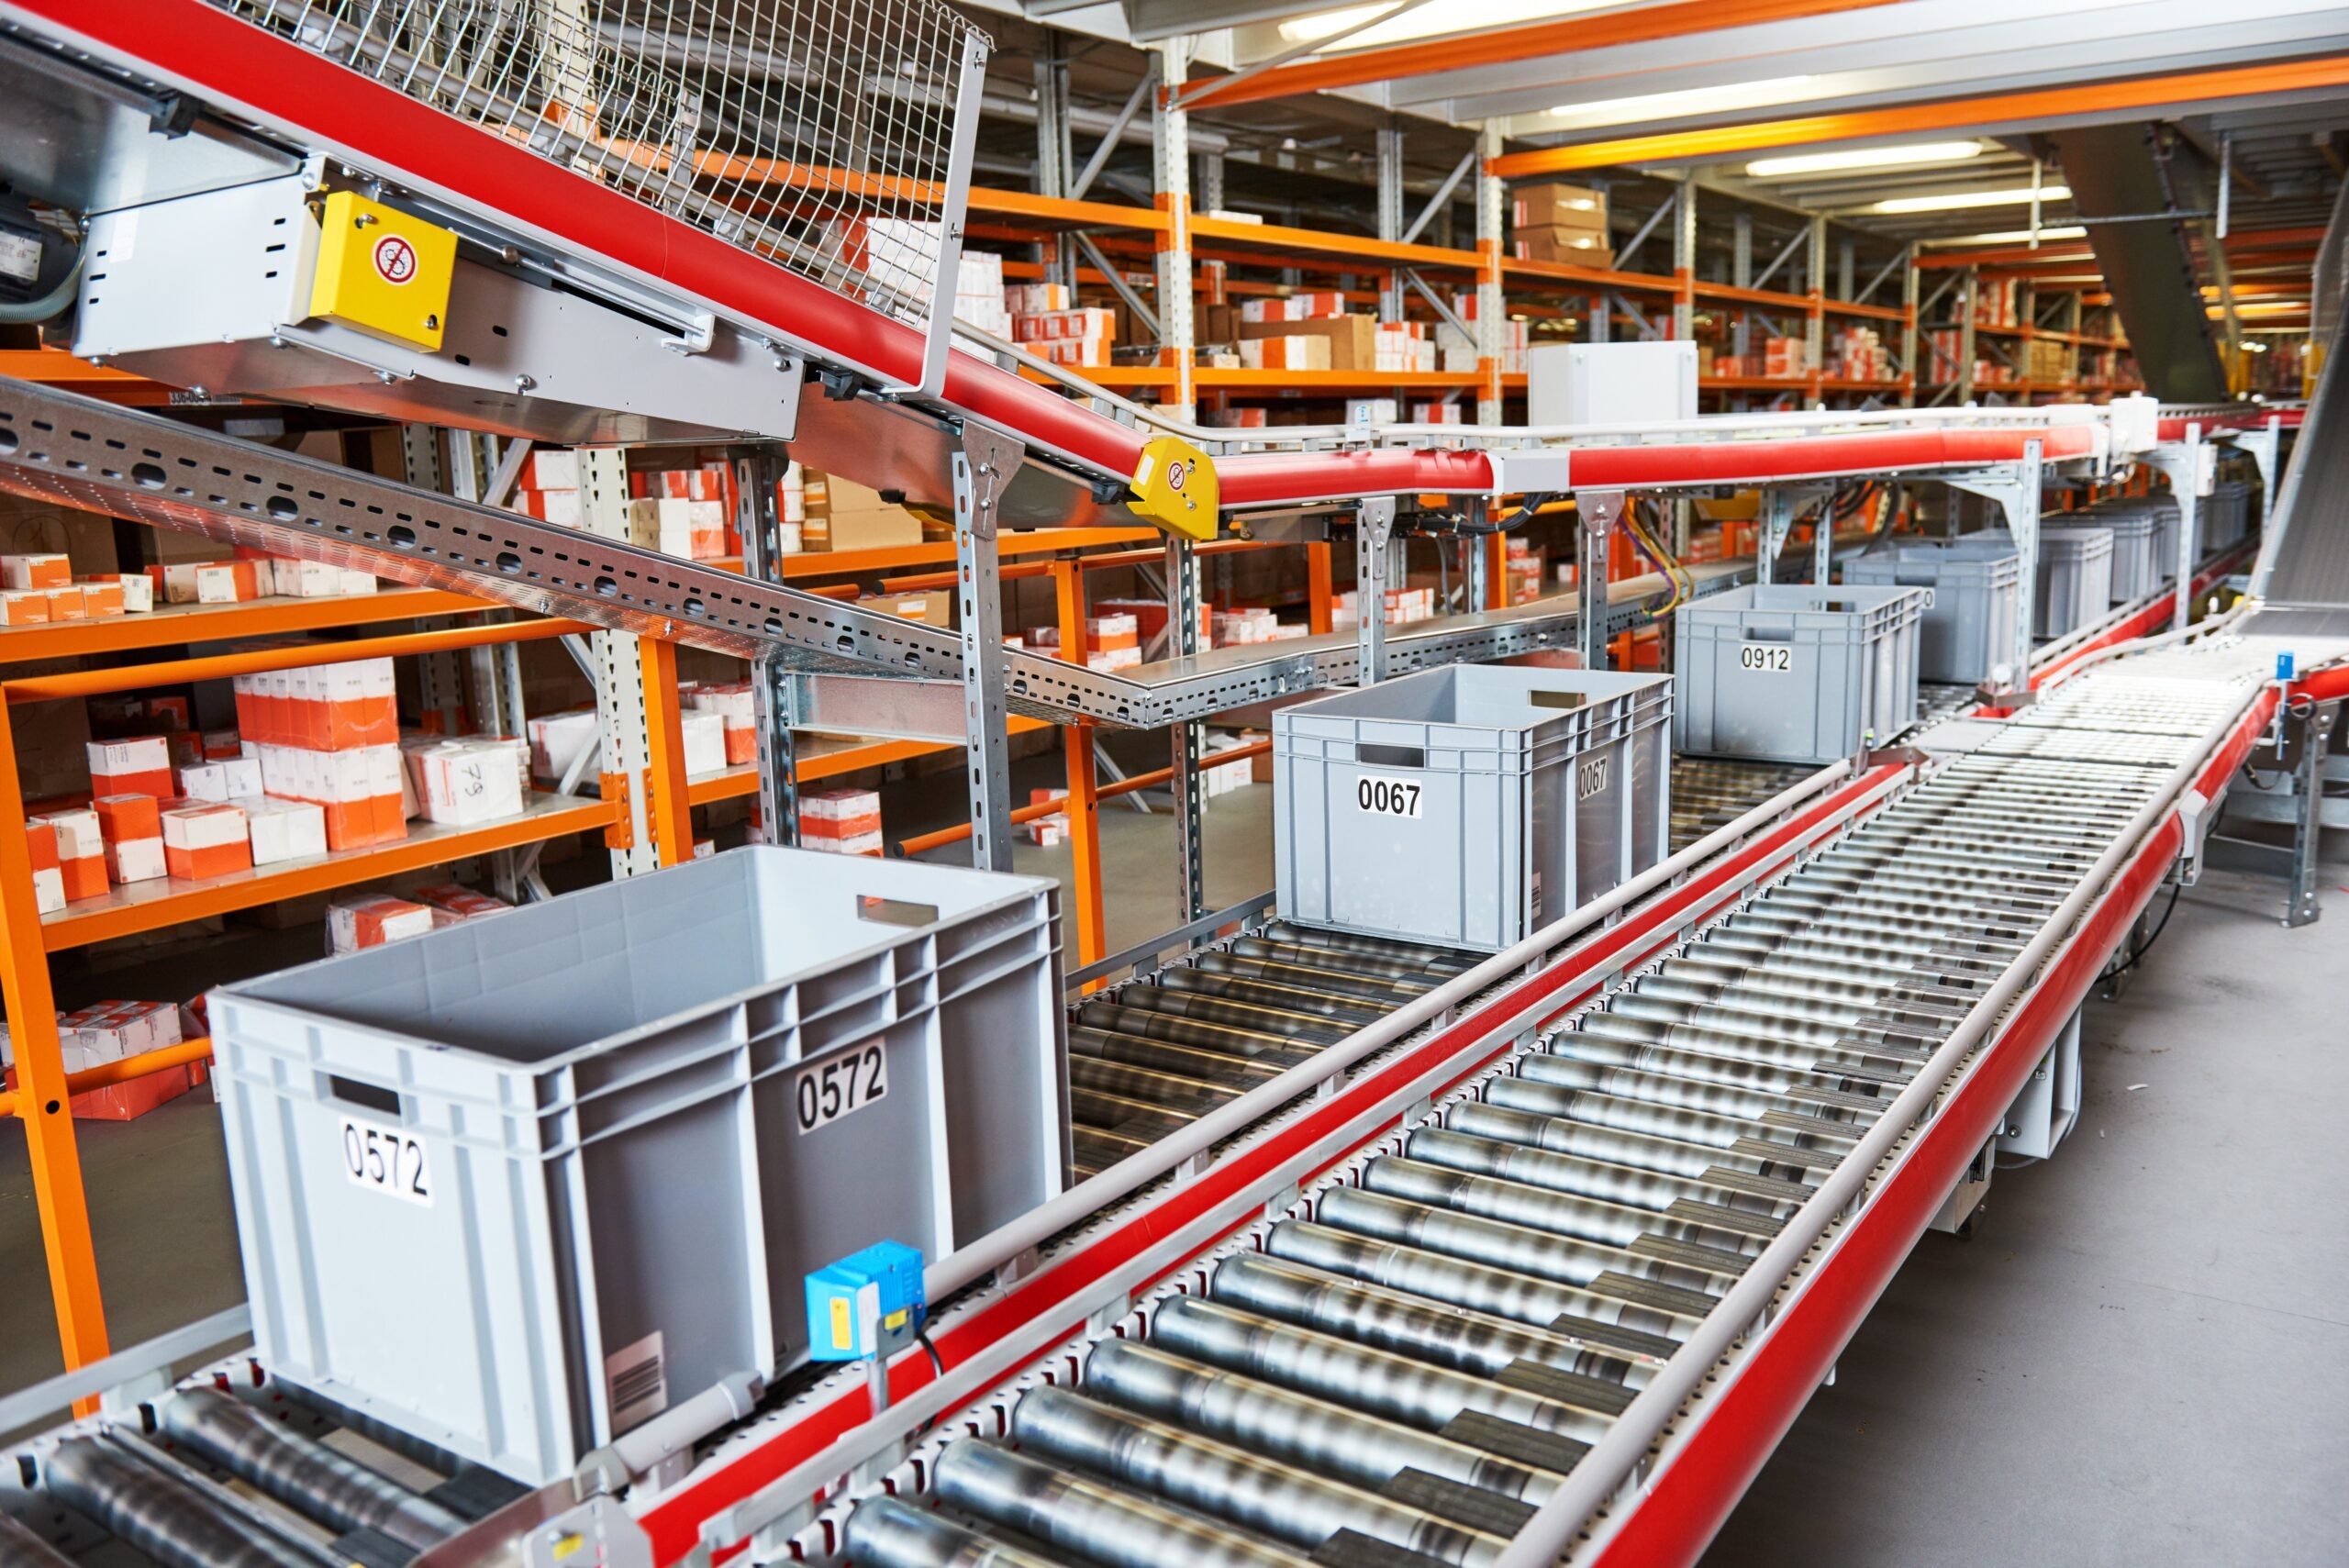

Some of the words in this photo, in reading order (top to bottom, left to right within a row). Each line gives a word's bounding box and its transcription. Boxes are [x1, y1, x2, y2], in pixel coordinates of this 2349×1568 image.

[1742, 647, 1788, 671] 0912
[1358, 778, 1420, 817] 0067
[1578, 758, 1607, 798] 0067
[797, 1045, 884, 1130] 0572
[344, 1123, 428, 1197] 0572
